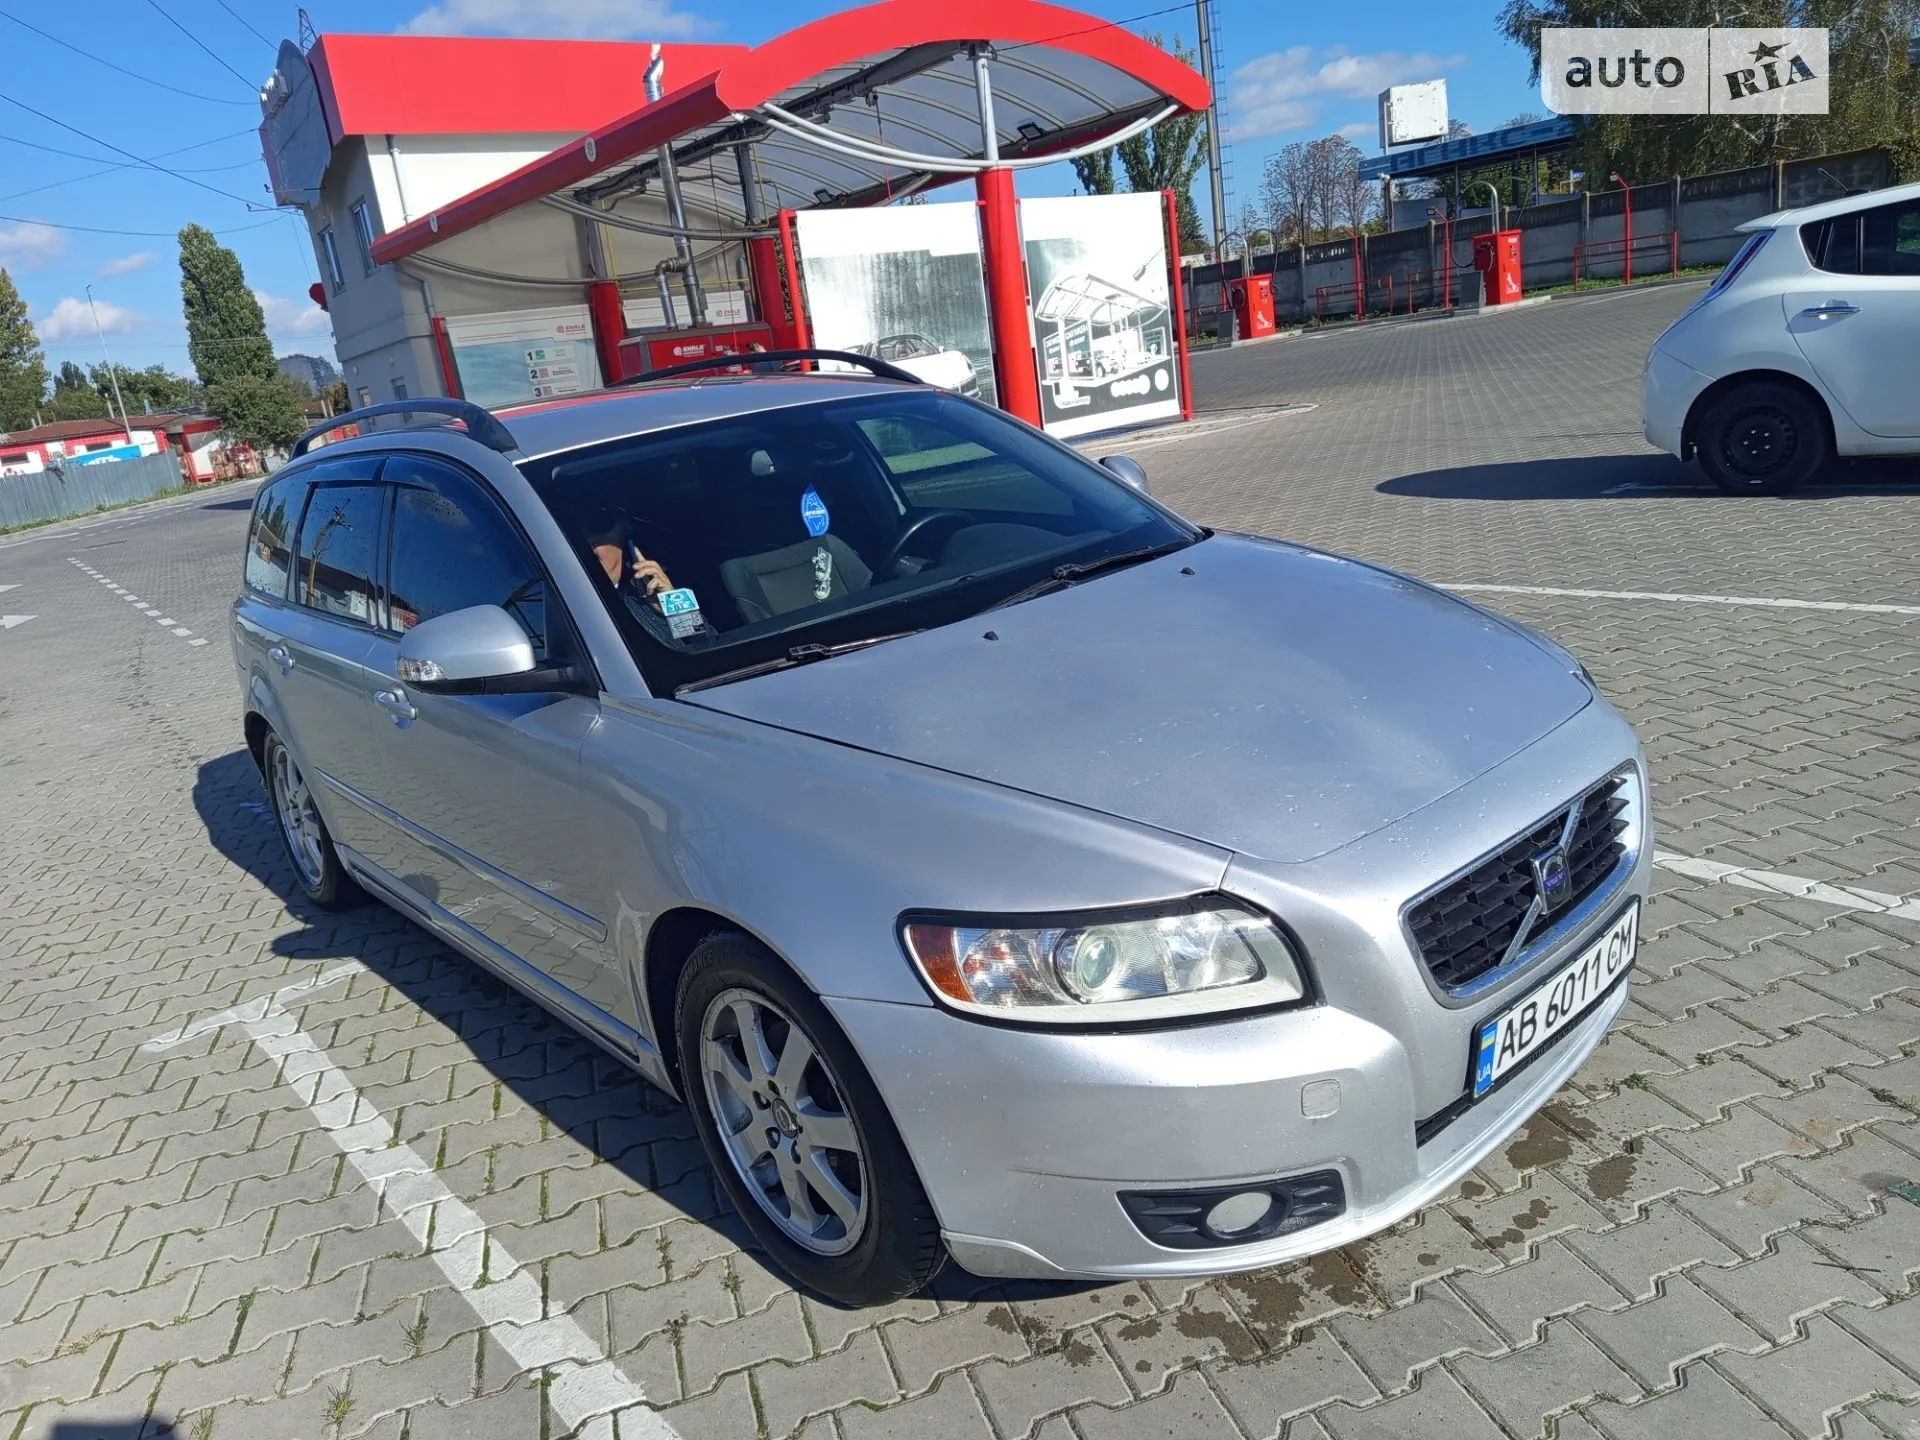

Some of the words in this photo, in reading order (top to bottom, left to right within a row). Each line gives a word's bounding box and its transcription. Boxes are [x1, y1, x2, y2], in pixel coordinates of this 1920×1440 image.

[527, 351, 534, 361] 1
[530, 369, 539, 379] 2
[534, 387, 542, 397] 3
[1497, 1000, 1538, 1069] AB
[1545, 947, 1602, 1029] 6011
[1607, 913, 1634, 976] CM
[1478, 1062, 1491, 1082] UA
